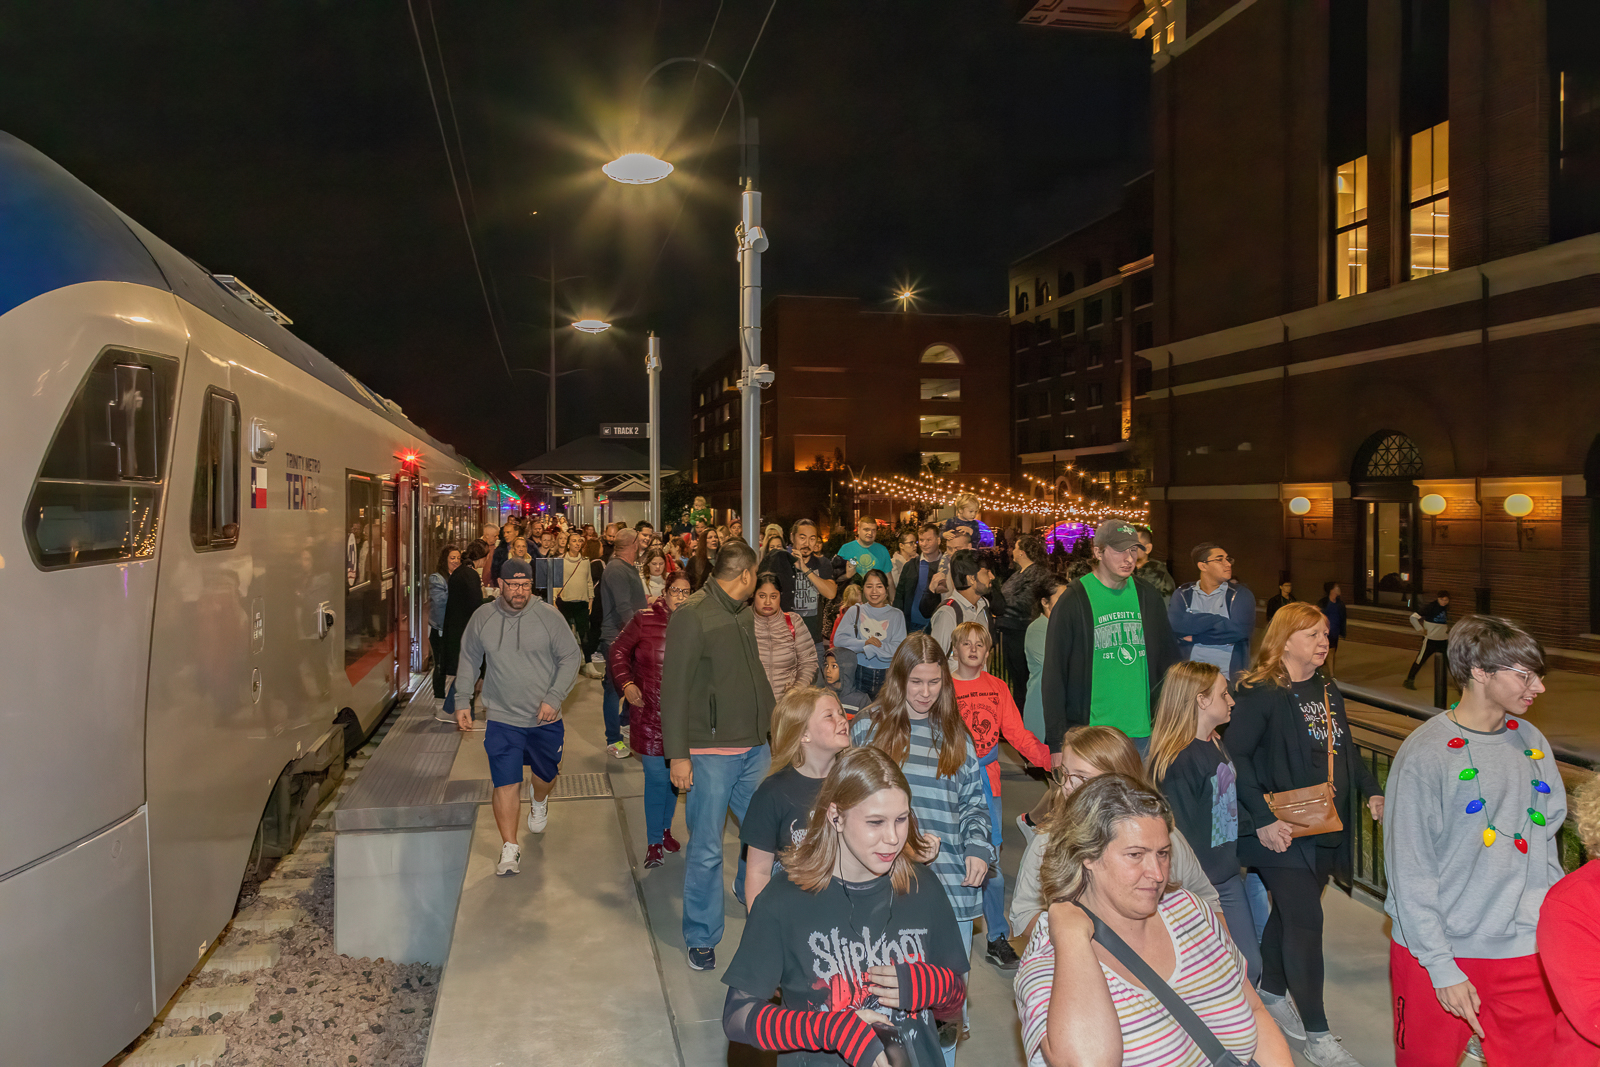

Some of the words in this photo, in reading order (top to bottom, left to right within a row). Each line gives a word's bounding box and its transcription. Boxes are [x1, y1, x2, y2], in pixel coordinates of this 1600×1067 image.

[613, 426, 634, 435] TRACK
[634, 426, 639, 435] 2
[286, 452, 304, 471] TRINITY
[1098, 611, 1135, 624] UNIVERSITY
[1094, 622, 1122, 650] NORTH
[1122, 622, 1146, 645] TEX
